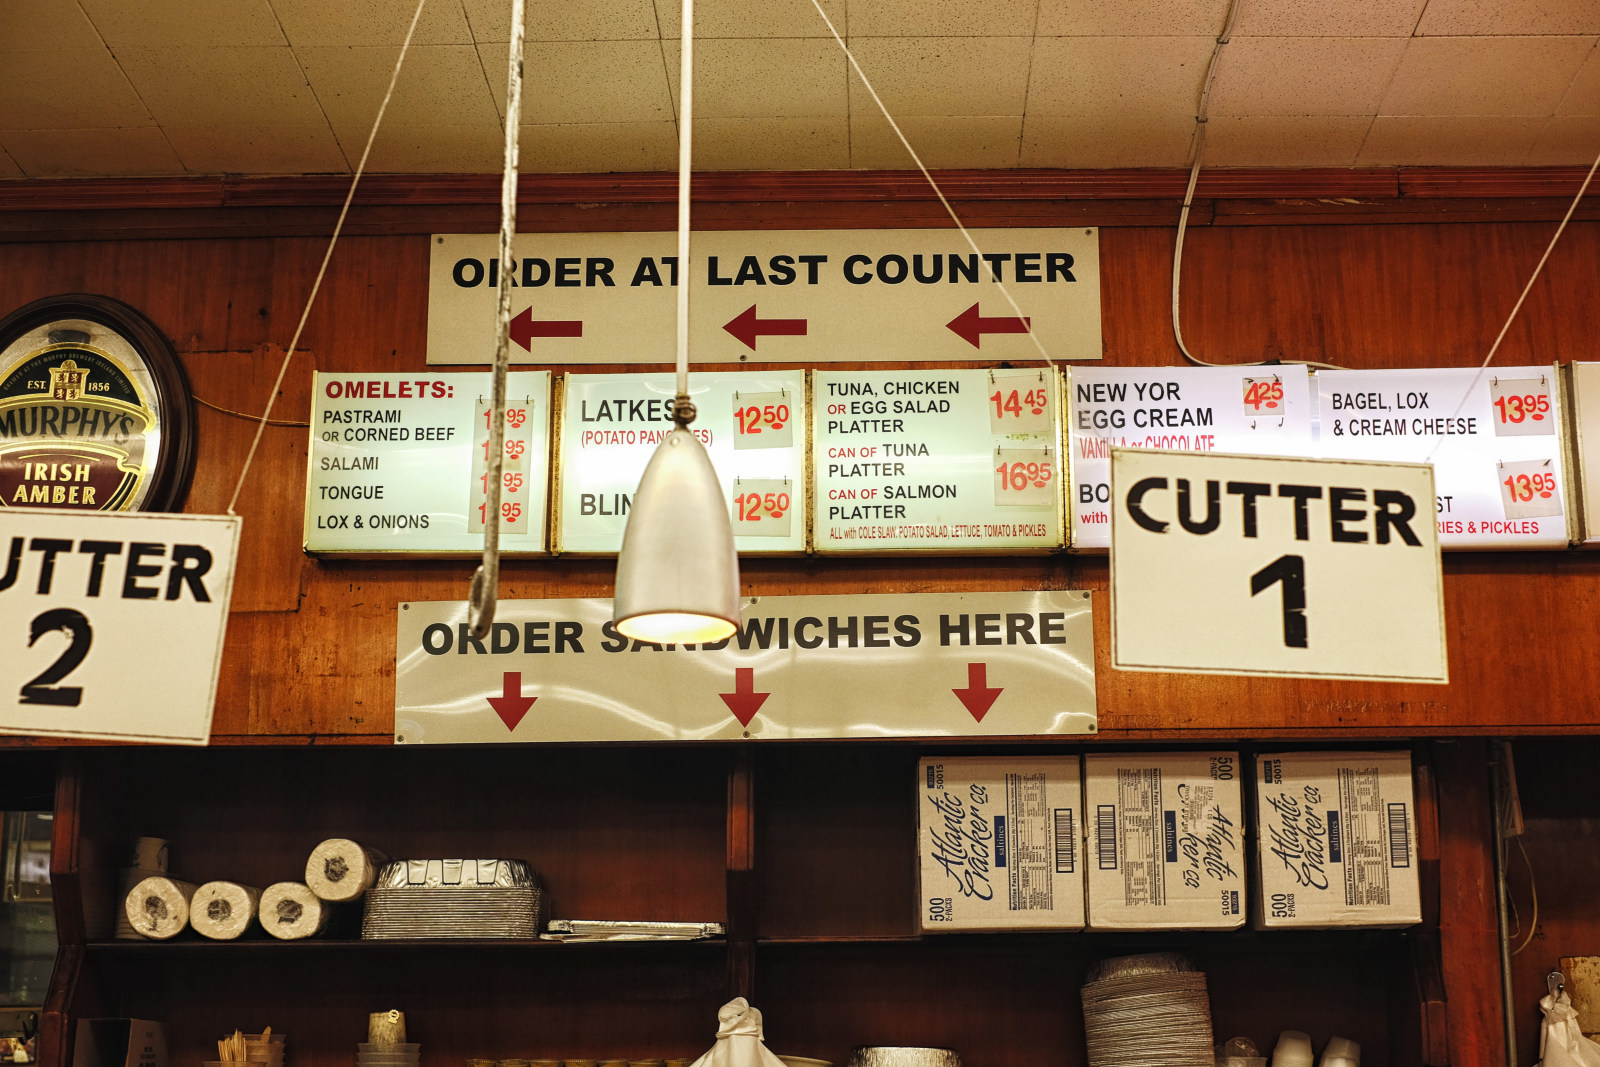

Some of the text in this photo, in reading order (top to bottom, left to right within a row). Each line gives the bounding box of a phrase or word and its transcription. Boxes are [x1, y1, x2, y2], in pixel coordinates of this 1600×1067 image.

[452, 252, 1077, 288] ORDER AT LAST COUNTER
[27, 380, 110, 392] EST. 1856
[325, 380, 454, 399] OMELETS:
[827, 381, 960, 397] TUNA, CHICKEN
[1077, 382, 1181, 403] NEW YOR
[581, 399, 676, 422] LATKES
[827, 400, 950, 415] OR EGG SALAD
[1332, 392, 1429, 412] BAGEL, LOX
[0, 405, 134, 446] MURPHY'S
[323, 409, 402, 424] PASTRAMI
[828, 419, 904, 434] PLATTER
[1078, 408, 1213, 430] EGG CREAM
[1333, 417, 1477, 436] & CREAM CHEESE
[322, 427, 455, 442] OR CORNED BEEF
[581, 429, 713, 448] (POTATO PANES)
[828, 443, 929, 458] CAN OF TUNA
[24, 462, 91, 482] IRISH
[320, 456, 379, 471] SALAMI
[828, 463, 905, 477] PLATTER
[13, 484, 96, 505] AMBER
[319, 486, 384, 500] TONGUE
[828, 484, 957, 500] CAN OF SALMON
[1080, 483, 1110, 504] BO
[581, 494, 635, 516] BLIN
[829, 505, 906, 520] PLATTER
[1126, 476, 1423, 547] CUTTER
[317, 514, 430, 529] LOX & ONIONS
[1081, 511, 1108, 524] with
[1467, 521, 1476, 534] &
[1481, 521, 1539, 534] PICKLES
[830, 527, 842, 540] ALL
[843, 527, 857, 539] with
[858, 526, 876, 539] COLE
[899, 525, 925, 538] POTATO
[925, 525, 949, 540] SALAD,
[951, 524, 982, 539] LETTUCE,
[984, 524, 1011, 538] TOMATO
[1012, 524, 1017, 537] &
[1018, 523, 1046, 537] PICKLES
[0, 537, 213, 603] UTTER
[1250, 554, 1309, 649] 1
[422, 621, 585, 655] ORDER
[939, 612, 1067, 647] HERE
[18, 607, 94, 708] 2
[936, 764, 944, 790] 50015
[1217, 757, 1233, 781] 500
[1273, 759, 1282, 785] 50015
[927, 792, 968, 892] Atlantic
[1202, 804, 1238, 881] Atlantic
[1265, 793, 1304, 883] Atlantic
[1295, 805, 1329, 890] Cracker
[960, 805, 993, 901] Cracker
[929, 897, 945, 922] 500
[945, 897, 953, 922] 2-PACKS
[1221, 889, 1230, 916] 50015
[1271, 893, 1287, 918] 500
[1287, 893, 1296, 918] 2-PACKS
